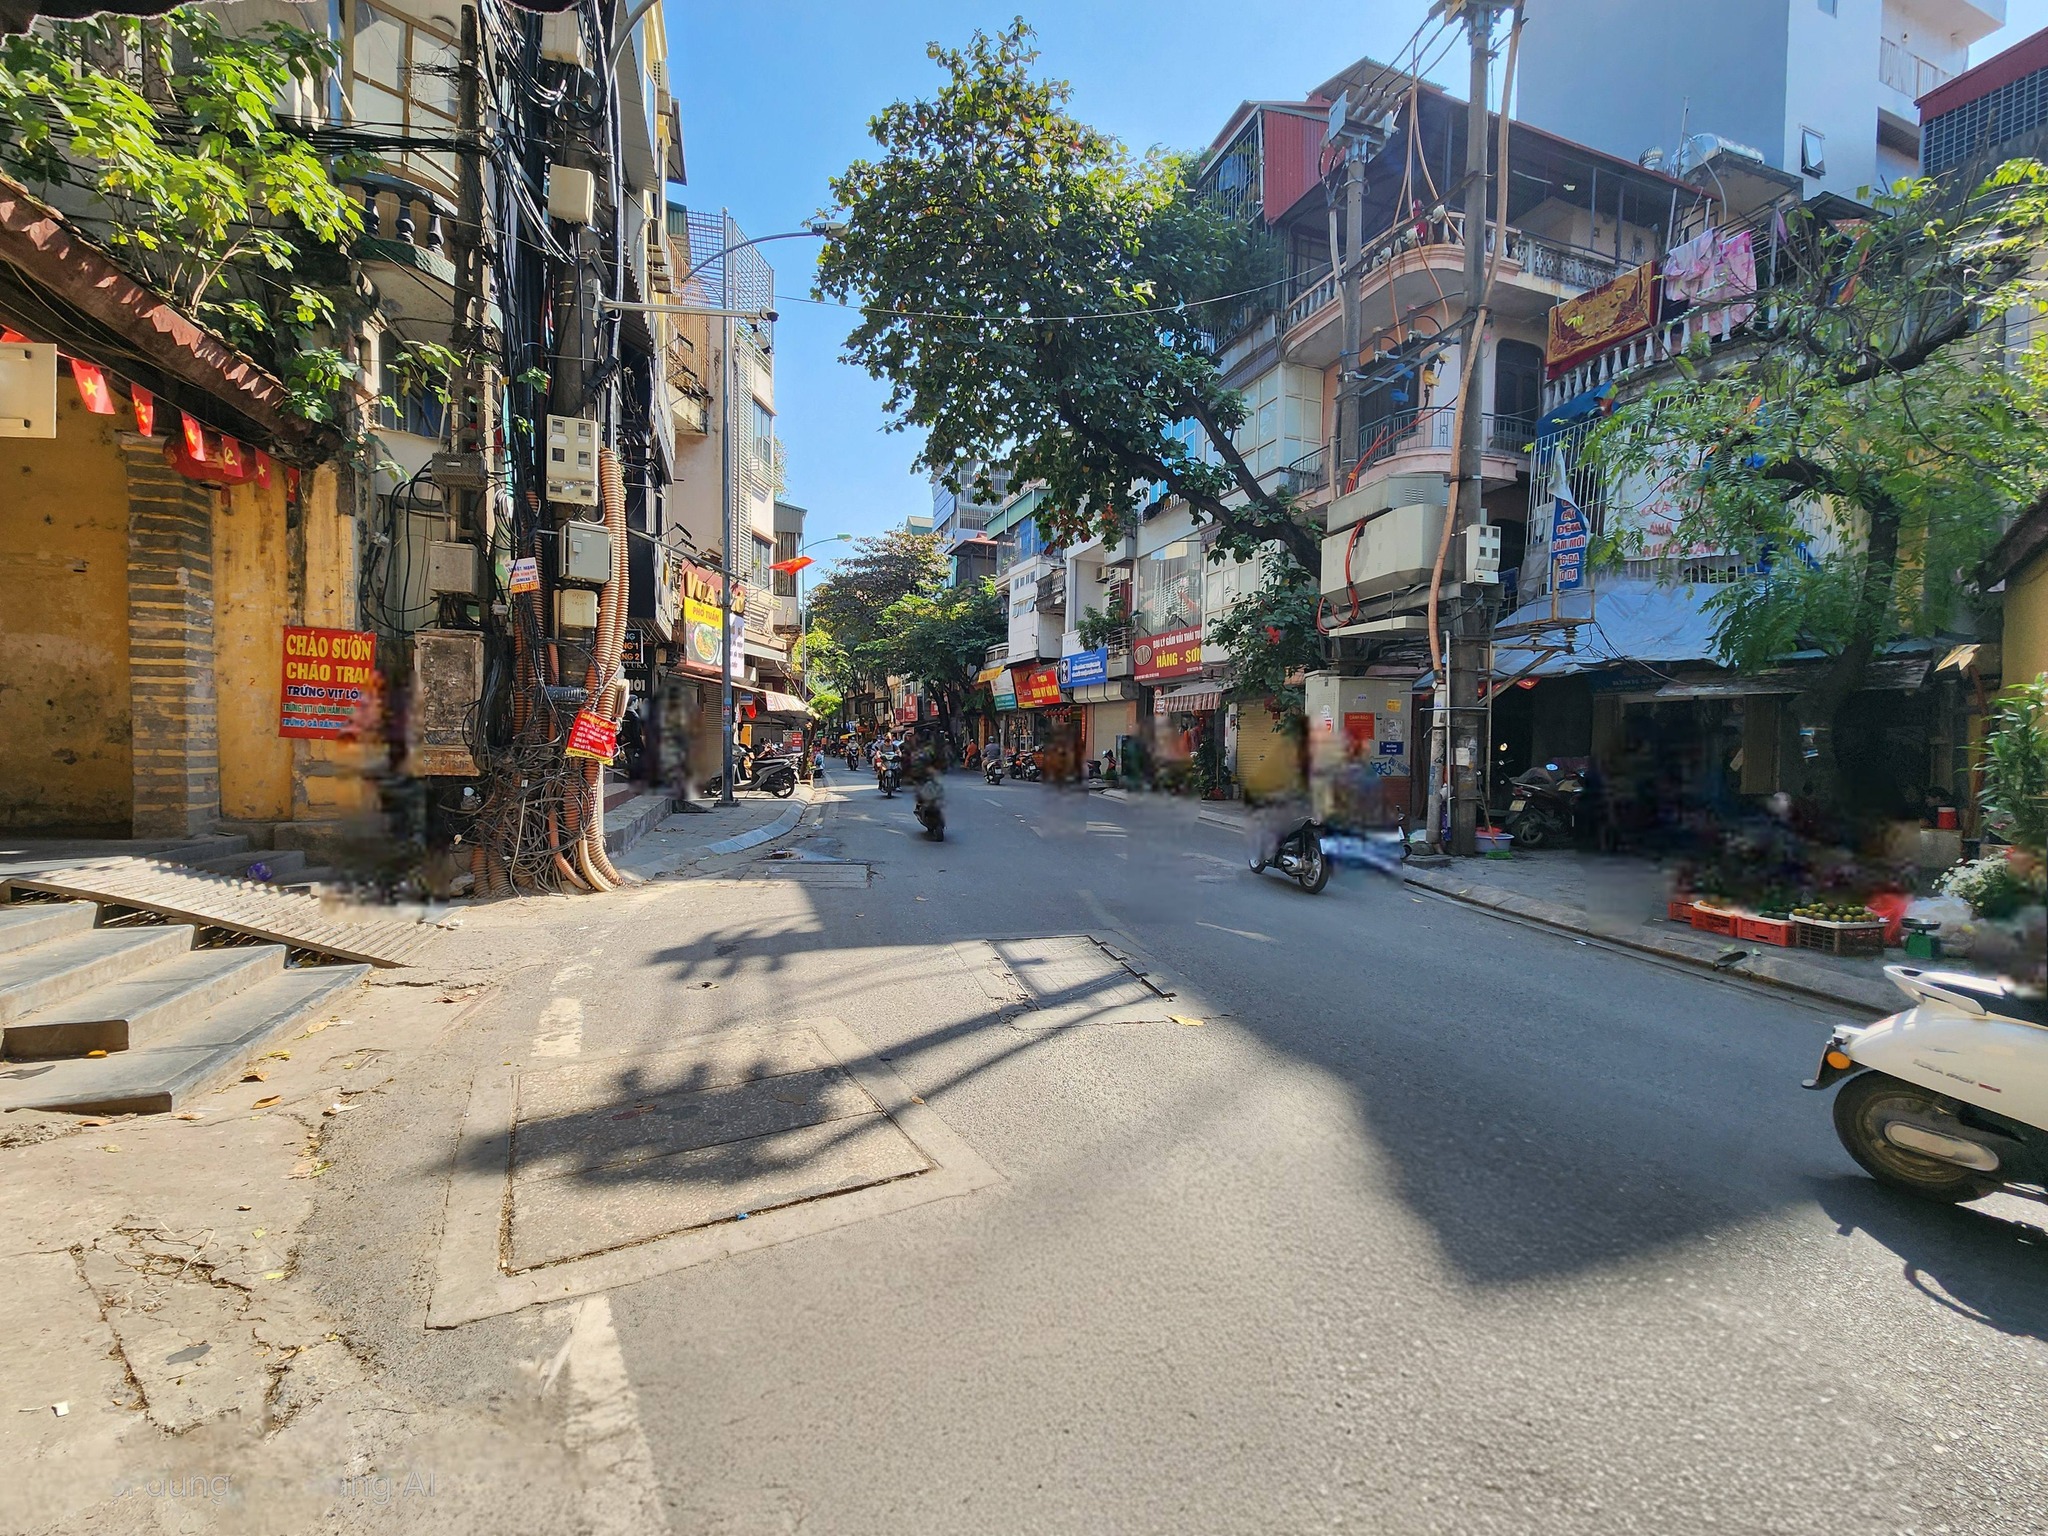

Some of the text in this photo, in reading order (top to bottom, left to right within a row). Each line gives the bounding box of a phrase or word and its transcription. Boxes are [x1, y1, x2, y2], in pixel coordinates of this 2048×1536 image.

[286, 630, 372, 661] CHÁO SƯỜN
[286, 660, 331, 681] CHÁO
[287, 684, 325, 698] TRỨNG
[327, 687, 345, 701] VỊT
